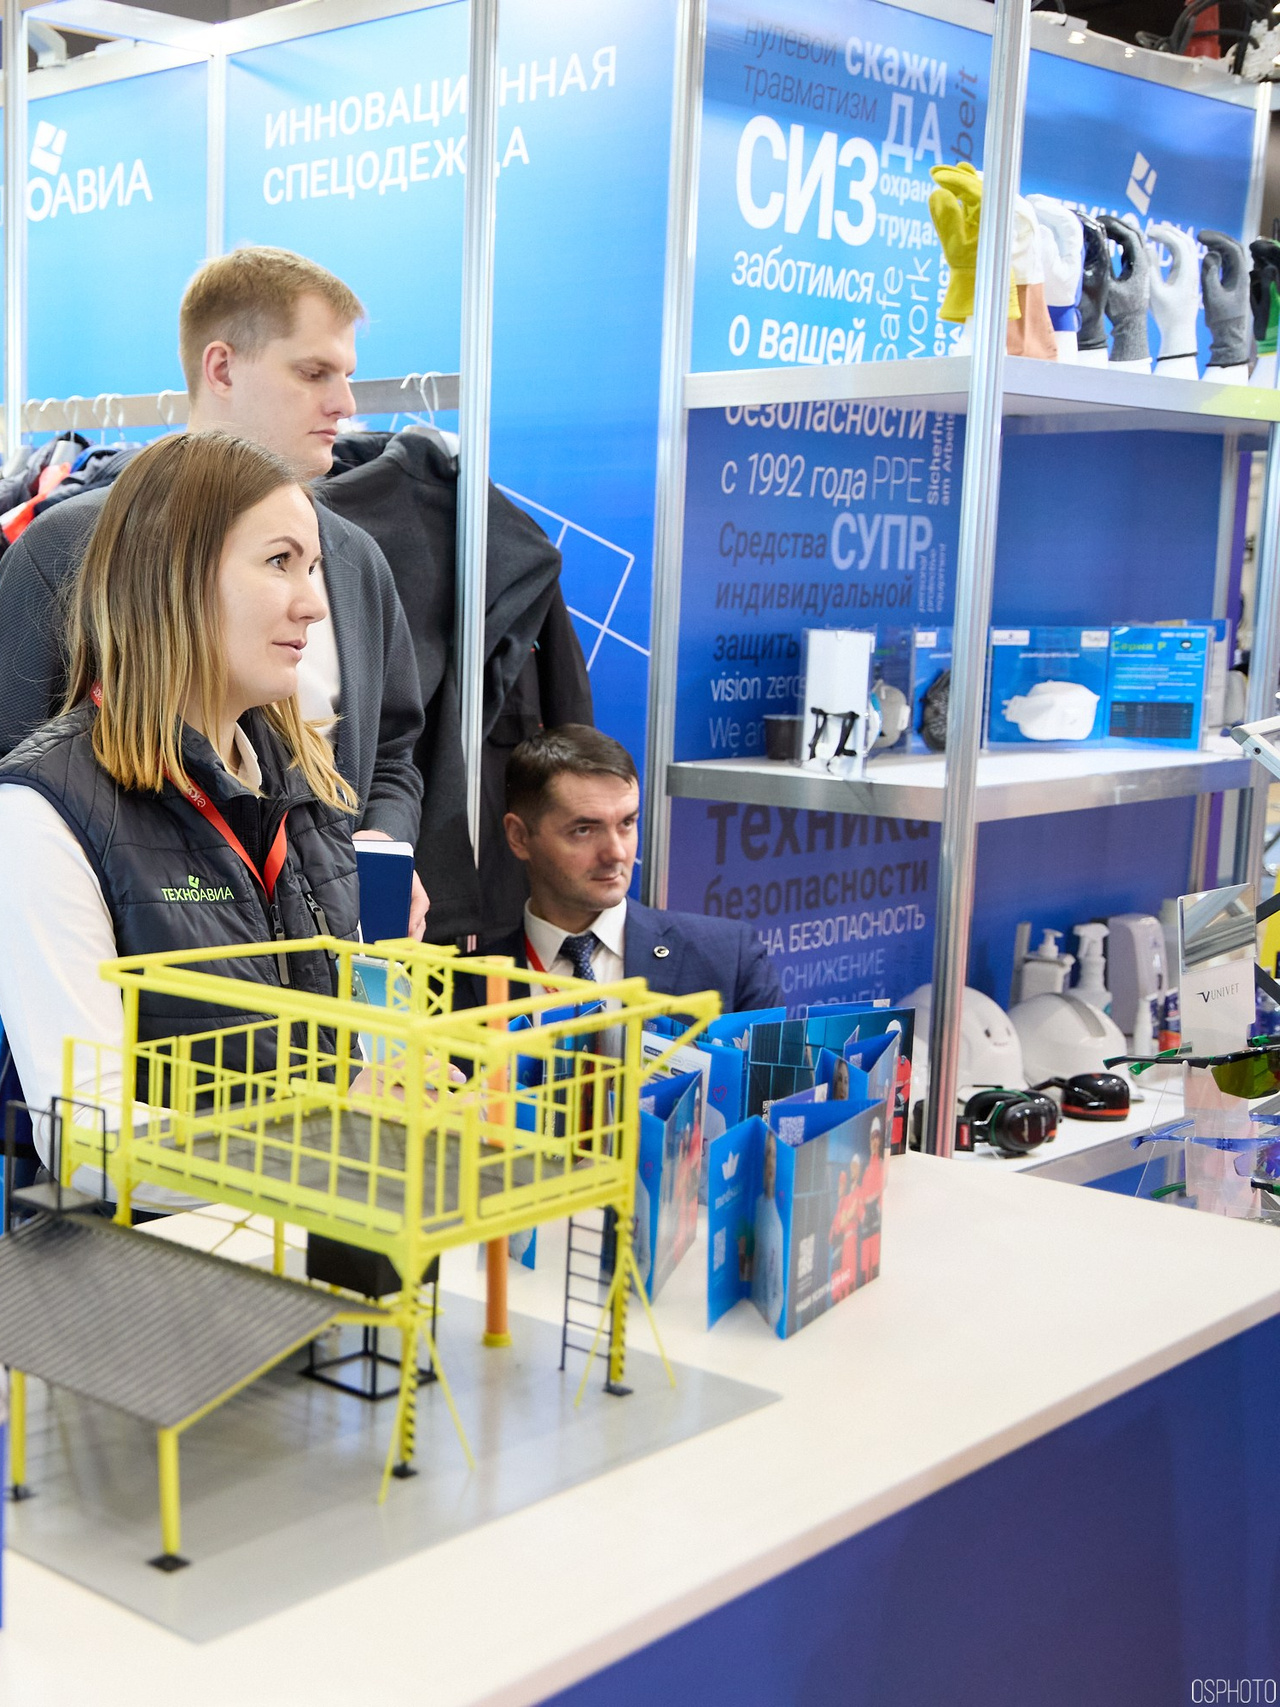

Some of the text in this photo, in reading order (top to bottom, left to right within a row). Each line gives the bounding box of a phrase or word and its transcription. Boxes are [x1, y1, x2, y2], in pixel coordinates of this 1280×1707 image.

[744, 17, 837, 67] нулевой
[844, 36, 948, 98] скажи
[265, 46, 617, 149] ИННОВАЦИННАЯ
[743, 64, 879, 123] травматизм
[881, 92, 943, 173] ДА
[263, 126, 530, 205] СПЕЦОДЕЖА
[736, 115, 880, 246] СИЗ
[880, 173, 940, 206] охран
[731, 245, 875, 304] заботимся
[729, 315, 866, 365] о вашей
[748, 452, 806, 498] 1992
[810, 466, 869, 508] года
[872, 455, 926, 504] PPE
[720, 521, 827, 567] Средства
[830, 512, 933, 571] СУПР
[716, 576, 913, 617] индивидуальной
[710, 671, 762, 702] vision
[708, 717, 740, 749] We
[161, 886, 235, 901] ТЕХНОАВИА
[703, 860, 929, 920] безопасности
[789, 903, 927, 953] БЕЗОПАСНОСТЬ
[780, 948, 886, 994] СНИЖЕНИЕ
